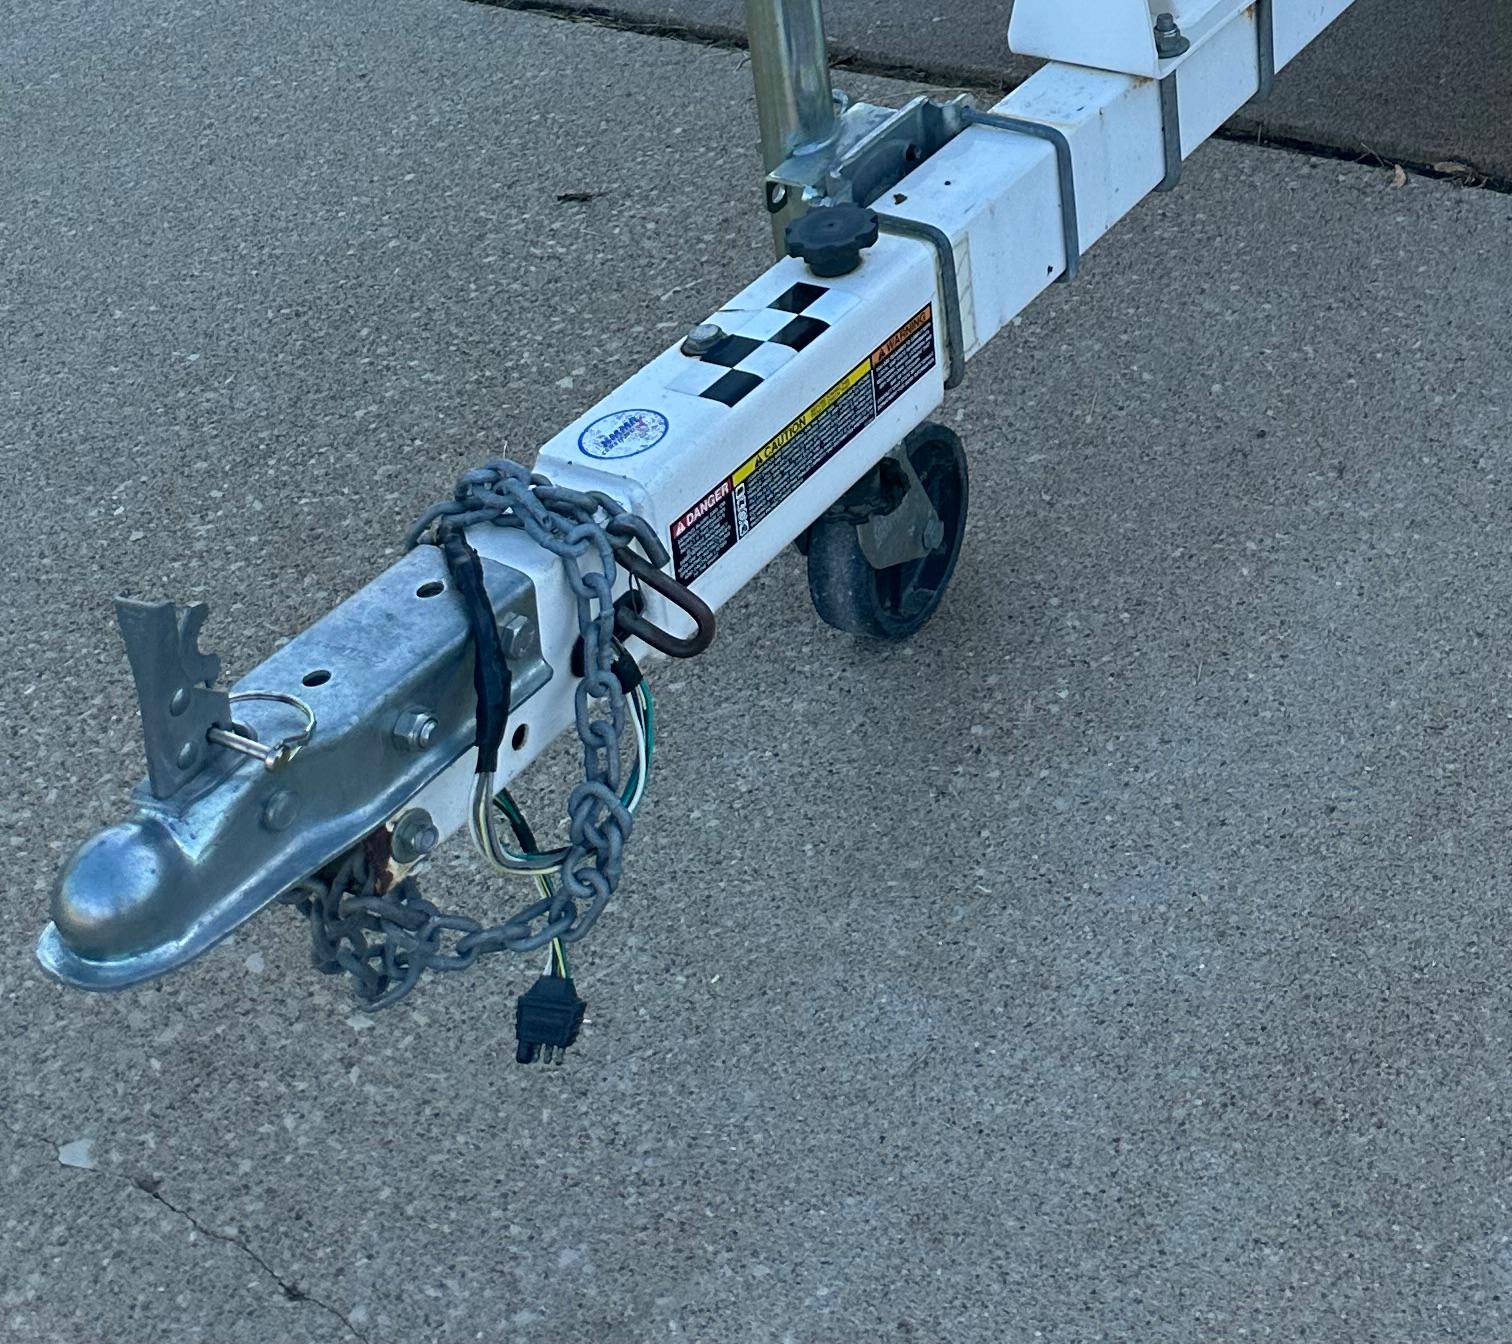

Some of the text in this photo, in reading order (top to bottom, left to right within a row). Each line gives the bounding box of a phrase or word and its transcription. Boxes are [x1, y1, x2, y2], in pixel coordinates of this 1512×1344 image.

[887, 313, 926, 349] WARNING
[765, 415, 807, 458] CAUTION
[686, 482, 730, 526] DANGER
